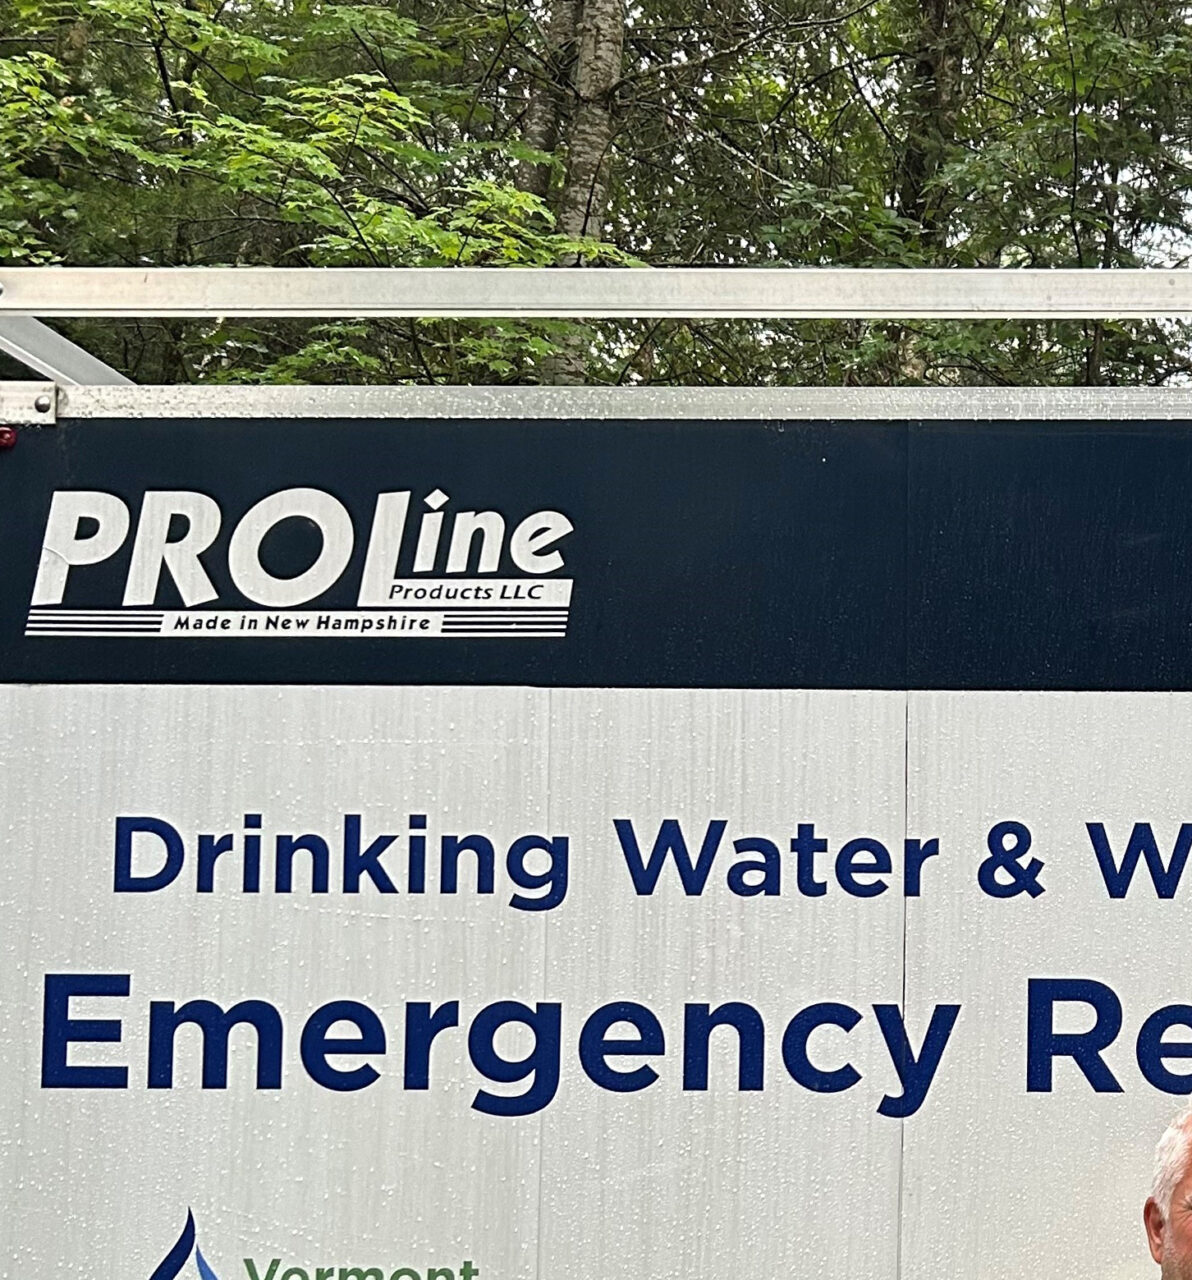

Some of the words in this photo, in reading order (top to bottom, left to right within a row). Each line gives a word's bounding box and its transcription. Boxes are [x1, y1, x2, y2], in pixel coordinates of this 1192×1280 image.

[388, 584, 494, 600] Products
[499, 584, 545, 600] LLC
[173, 615, 232, 630] Made
[239, 615, 259, 630] in
[265, 615, 310, 630] New
[316, 615, 431, 633] Hampshire
[114, 814, 569, 910] Drinking
[614, 820, 939, 898] Water
[978, 822, 1044, 897] &
[42, 974, 958, 1117] Emergency
